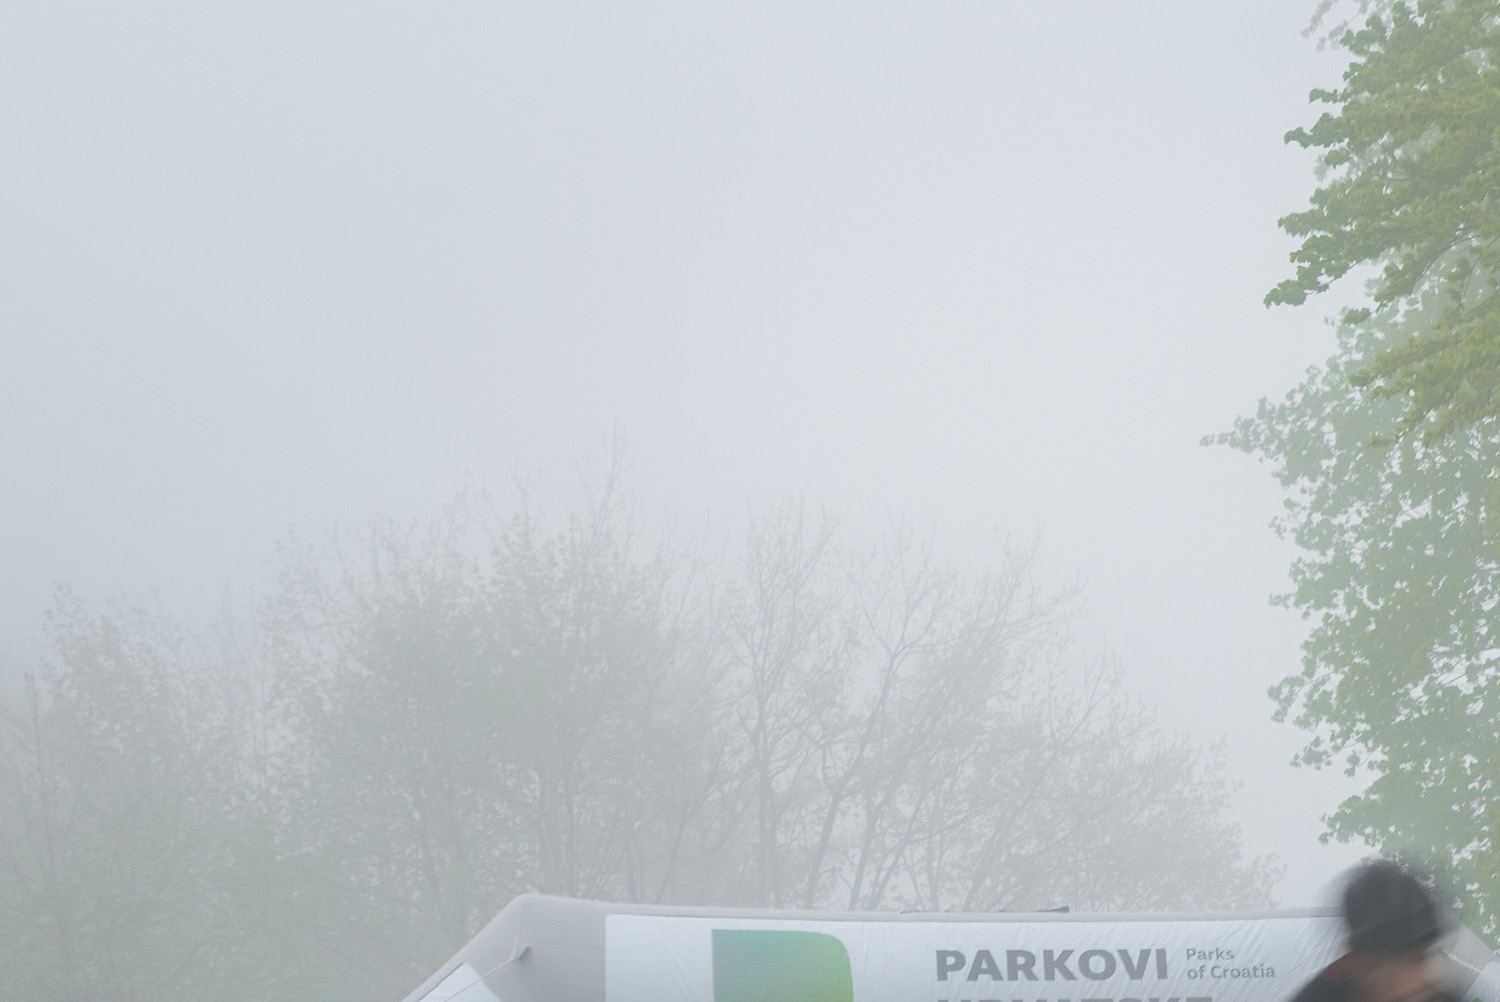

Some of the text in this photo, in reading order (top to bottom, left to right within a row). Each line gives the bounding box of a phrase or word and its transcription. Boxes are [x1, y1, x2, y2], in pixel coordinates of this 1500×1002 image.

[1186, 947, 1235, 961] Parks
[935, 947, 1169, 982] PARKOVI
[1187, 964, 1276, 980] of Croatia
